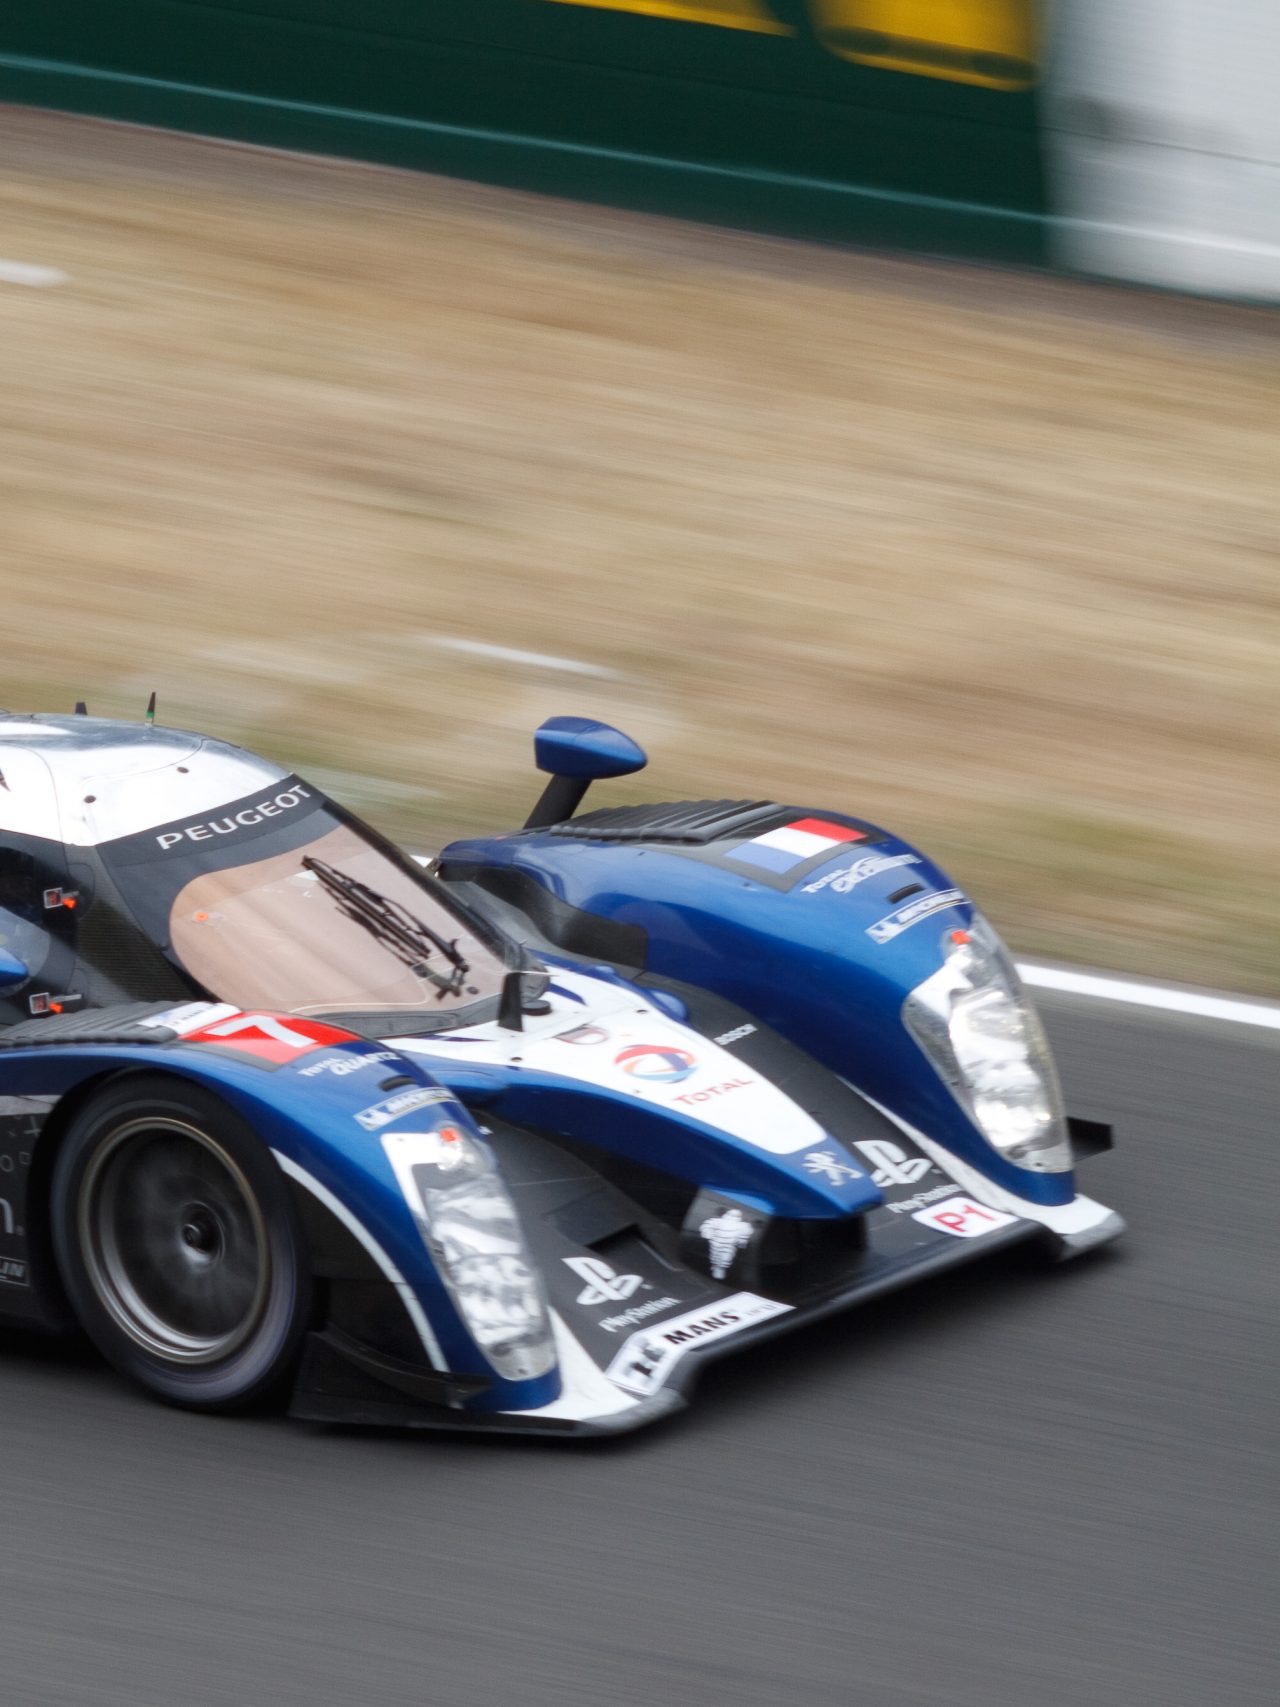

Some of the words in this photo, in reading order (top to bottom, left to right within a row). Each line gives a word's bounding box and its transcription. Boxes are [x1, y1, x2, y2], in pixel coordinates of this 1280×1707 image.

[155, 784, 311, 850] PEUGEOT
[203, 1014, 319, 1049] 7
[328, 1051, 403, 1076] QUARTZ
[673, 1077, 755, 1106] TOTAL
[931, 1204, 998, 1234] P1
[597, 1296, 683, 1333] PlayStation
[662, 1310, 742, 1346] MANS
